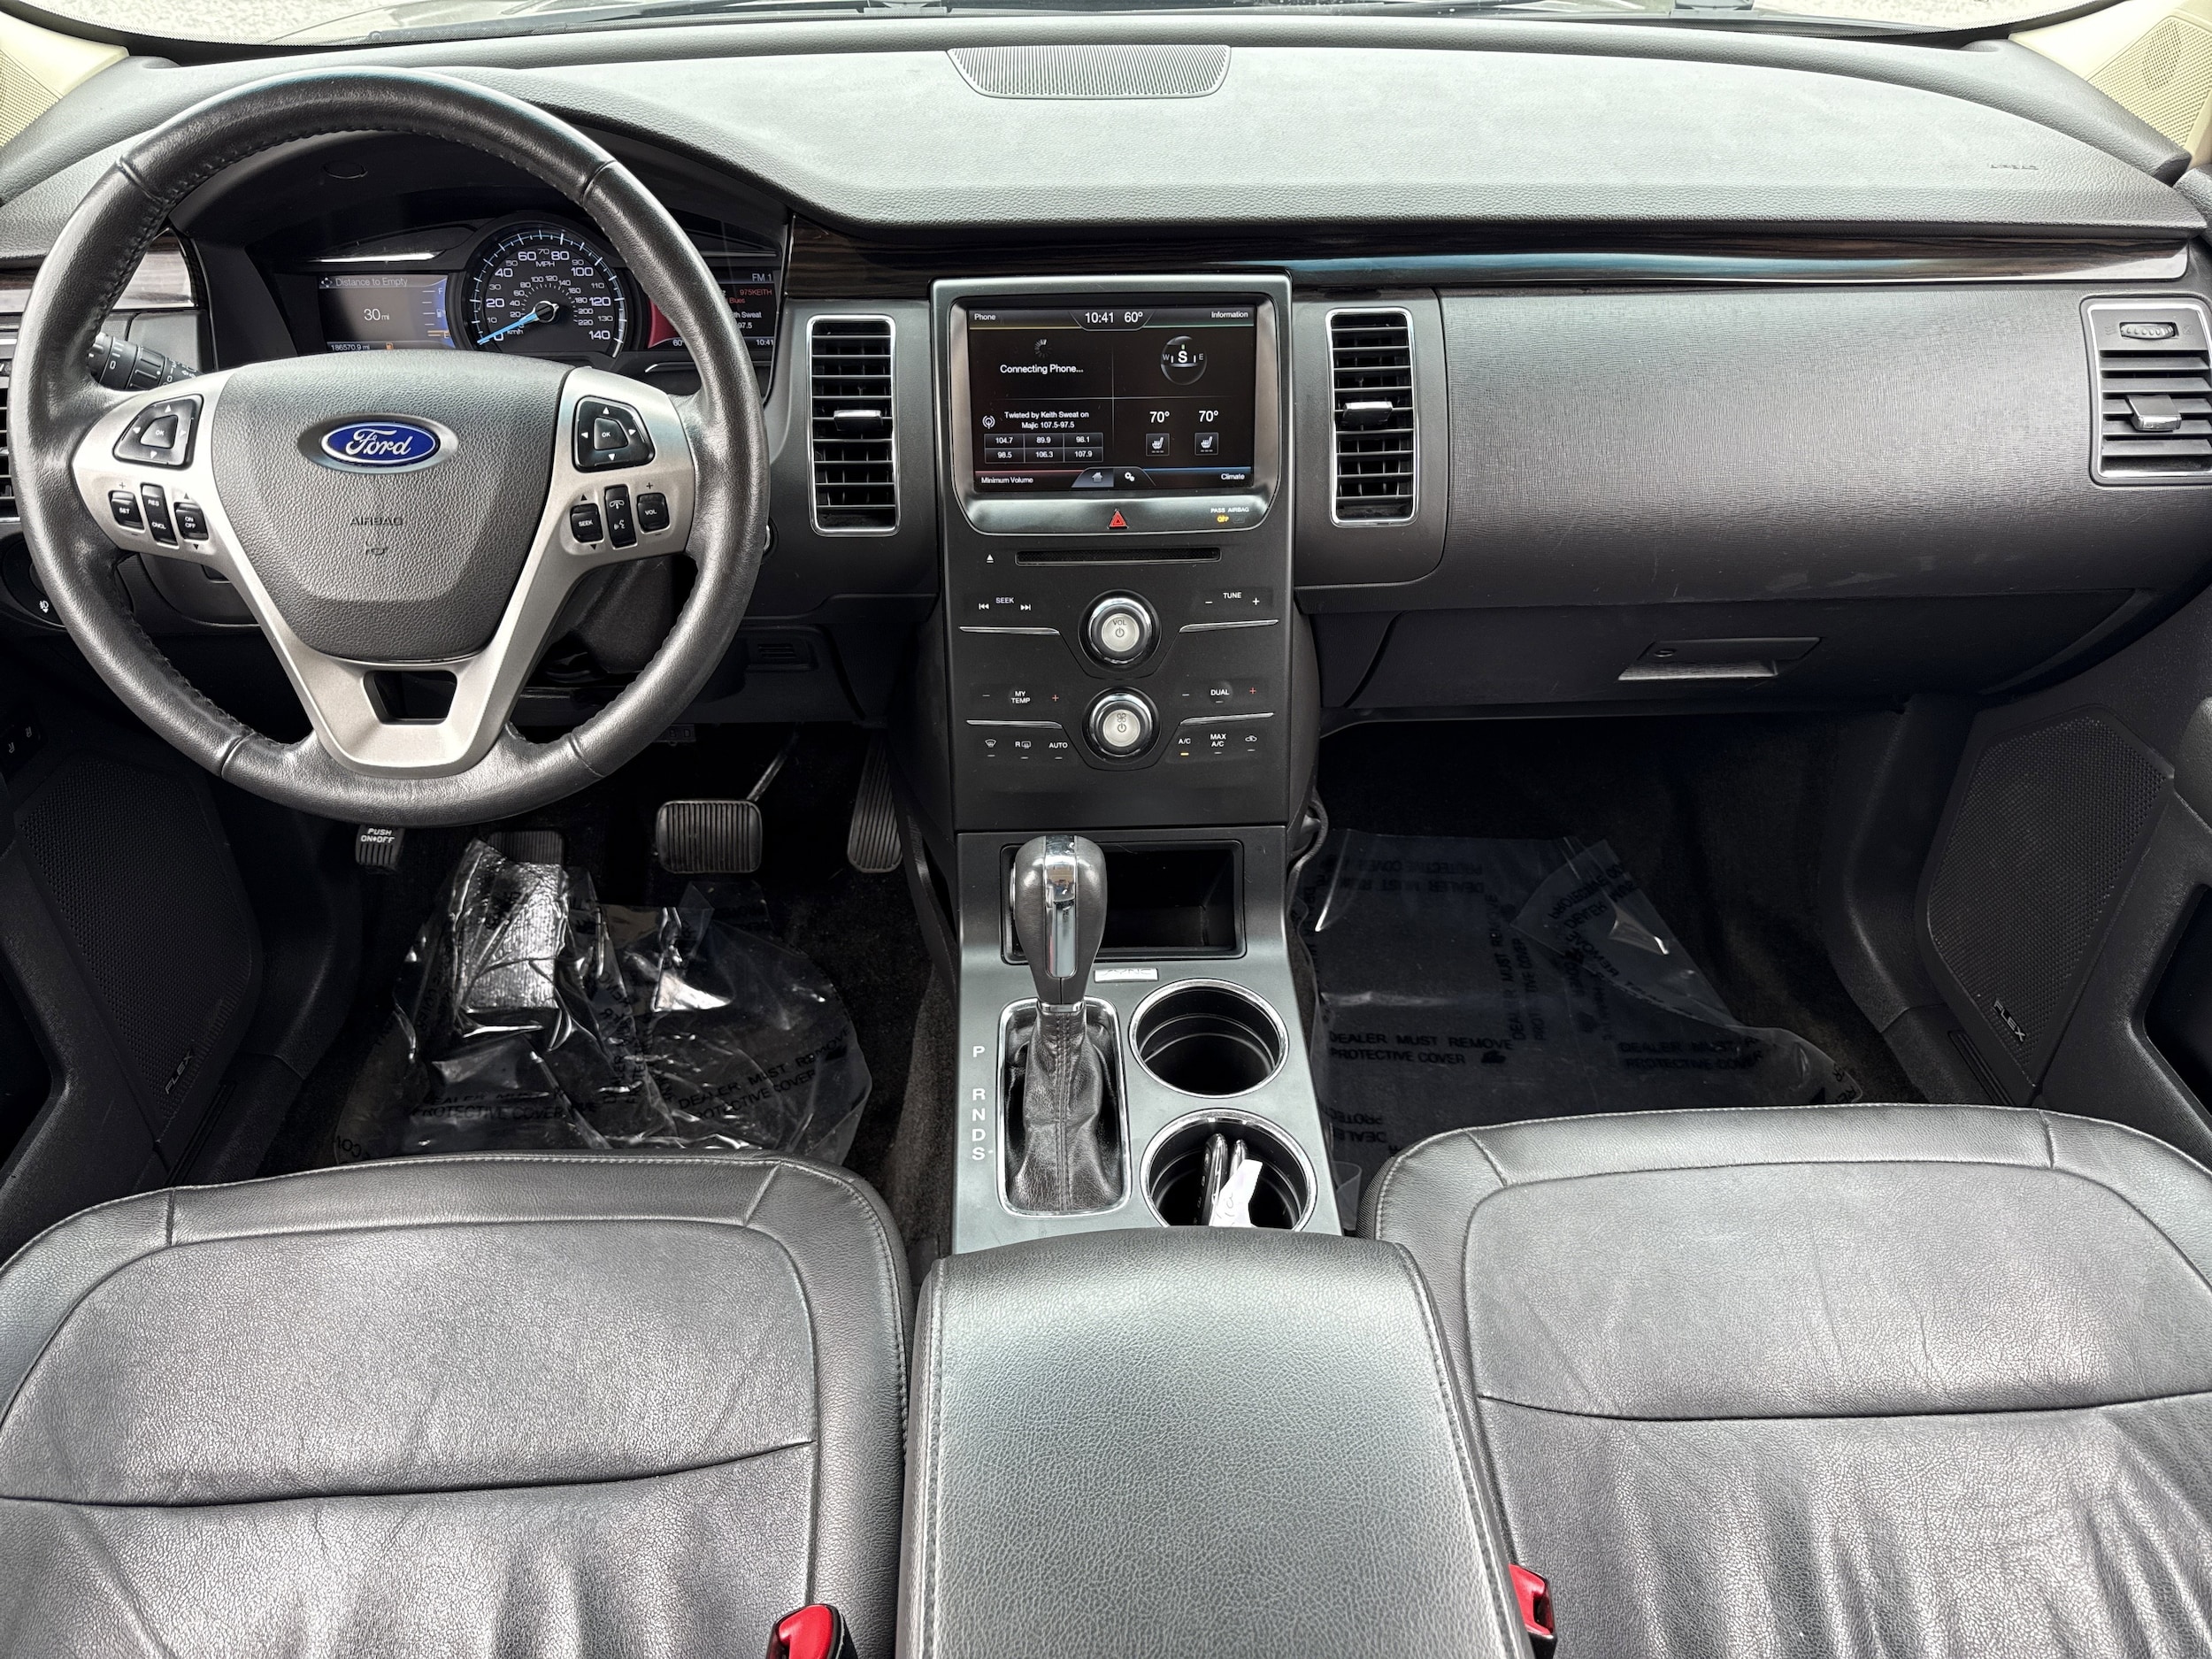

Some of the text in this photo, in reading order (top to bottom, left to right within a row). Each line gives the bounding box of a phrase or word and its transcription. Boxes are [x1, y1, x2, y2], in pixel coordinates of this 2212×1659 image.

[518, 251, 536, 261] 60
[551, 251, 570, 261] 80
[495, 268, 513, 278] 40
[571, 267, 594, 276] 100
[335, 278, 371, 287] Distance
[383, 277, 408, 288] Empty
[486, 298, 504, 307] 20
[589, 297, 611, 306] 120
[364, 309, 381, 320] 30
[974, 312, 995, 321] Phone
[1085, 311, 1143, 323] 10:41 60°
[588, 330, 611, 340] 140
[1178, 350, 1187, 363] S
[1000, 364, 1084, 374] Connecting Phone...
[1149, 411, 1170, 423] 70°
[1198, 410, 1219, 422] 70°
[346, 428, 413, 455] Ford
[350, 516, 403, 526] AIRBAG
[367, 827, 392, 836] PUSH
[1993, 998, 2026, 1042] FLEX
[1330, 1030, 1515, 1051] DEALER MUST REMOVE
[973, 1046, 985, 1057] P
[1330, 1048, 1466, 1064] PROTECTIVE COVER
[164, 1049, 194, 1095] FLEX
[774, 1069, 816, 1093] COVER
[680, 1081, 741, 1110] DEALER
[973, 1088, 986, 1101] R
[512, 1106, 563, 1120] COVER
[972, 1109, 986, 1121] N
[973, 1128, 986, 1141] D
[972, 1148, 986, 1160] S
